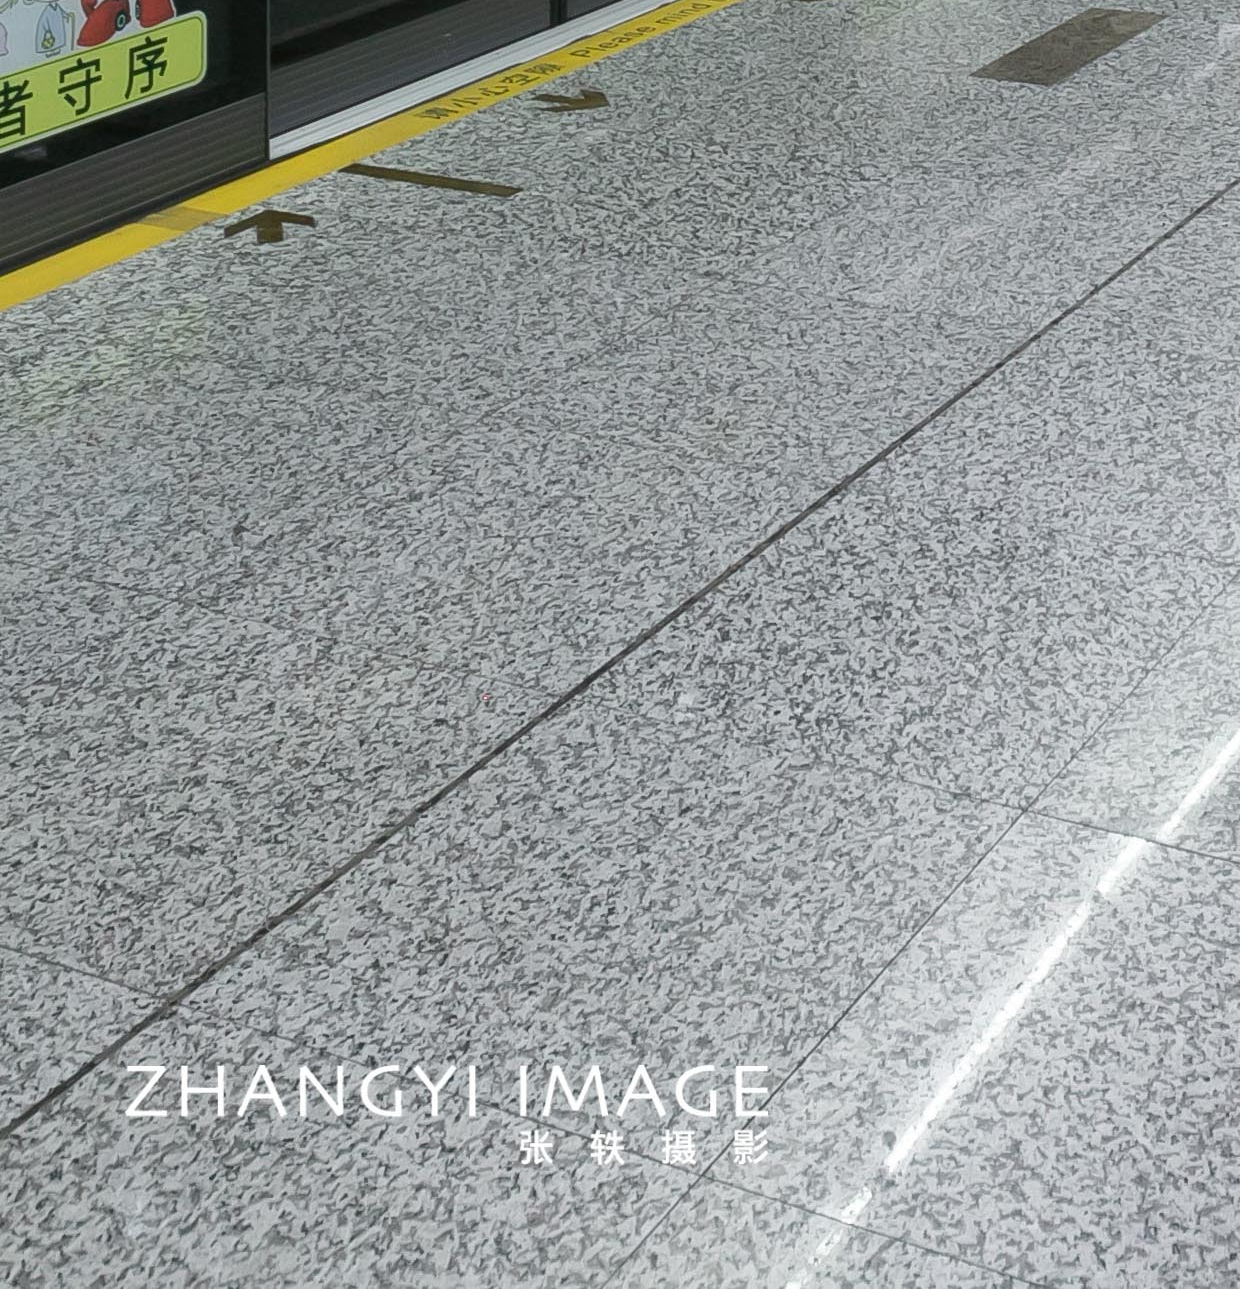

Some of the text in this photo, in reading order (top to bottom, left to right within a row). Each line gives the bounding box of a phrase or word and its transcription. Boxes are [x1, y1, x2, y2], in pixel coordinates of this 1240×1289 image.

[569, 26, 656, 58] Please
[656, 1, 711, 26] mind
[0, 36, 168, 138] 者守序
